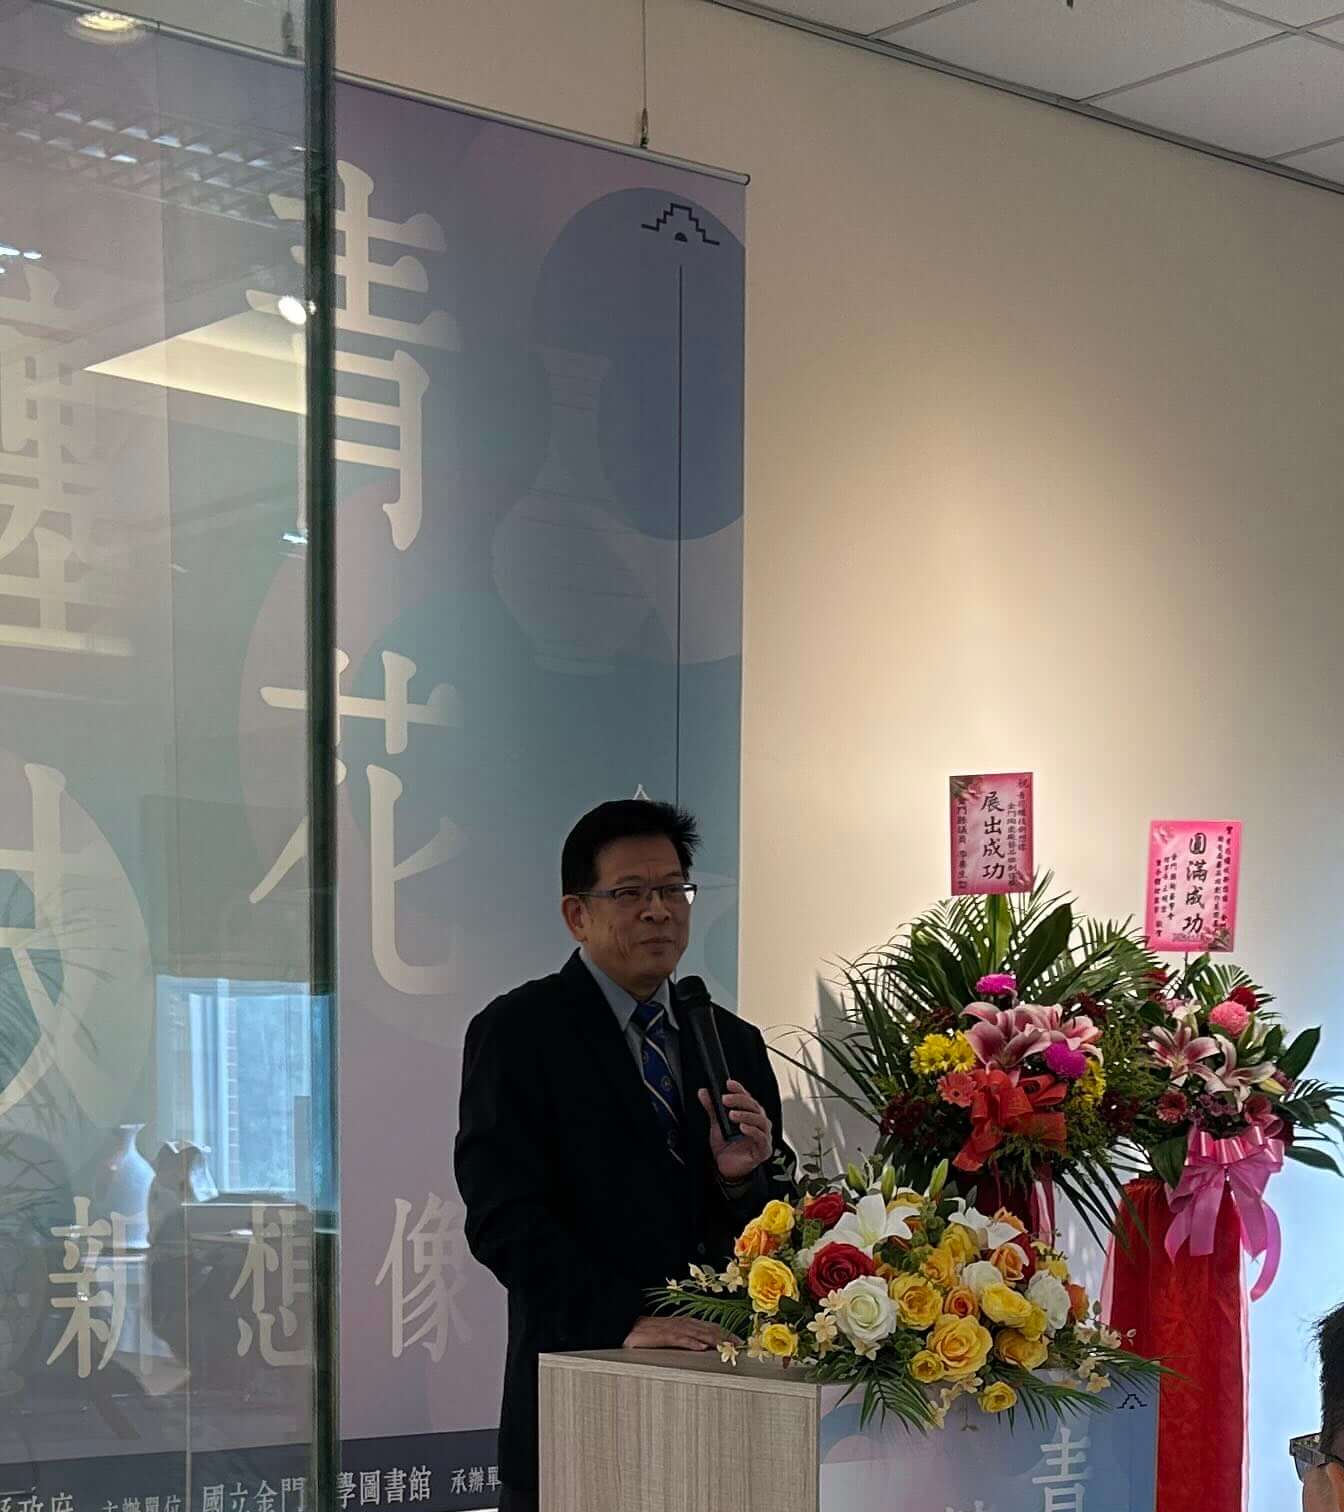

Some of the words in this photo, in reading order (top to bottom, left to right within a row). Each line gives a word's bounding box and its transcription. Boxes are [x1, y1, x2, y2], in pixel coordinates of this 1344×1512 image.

[246, 160, 462, 994] 青花
[981, 791, 1005, 879] 展出成功
[1182, 832, 1207, 934] 圓滿成功
[46, 1192, 472, 1378] 新想像
